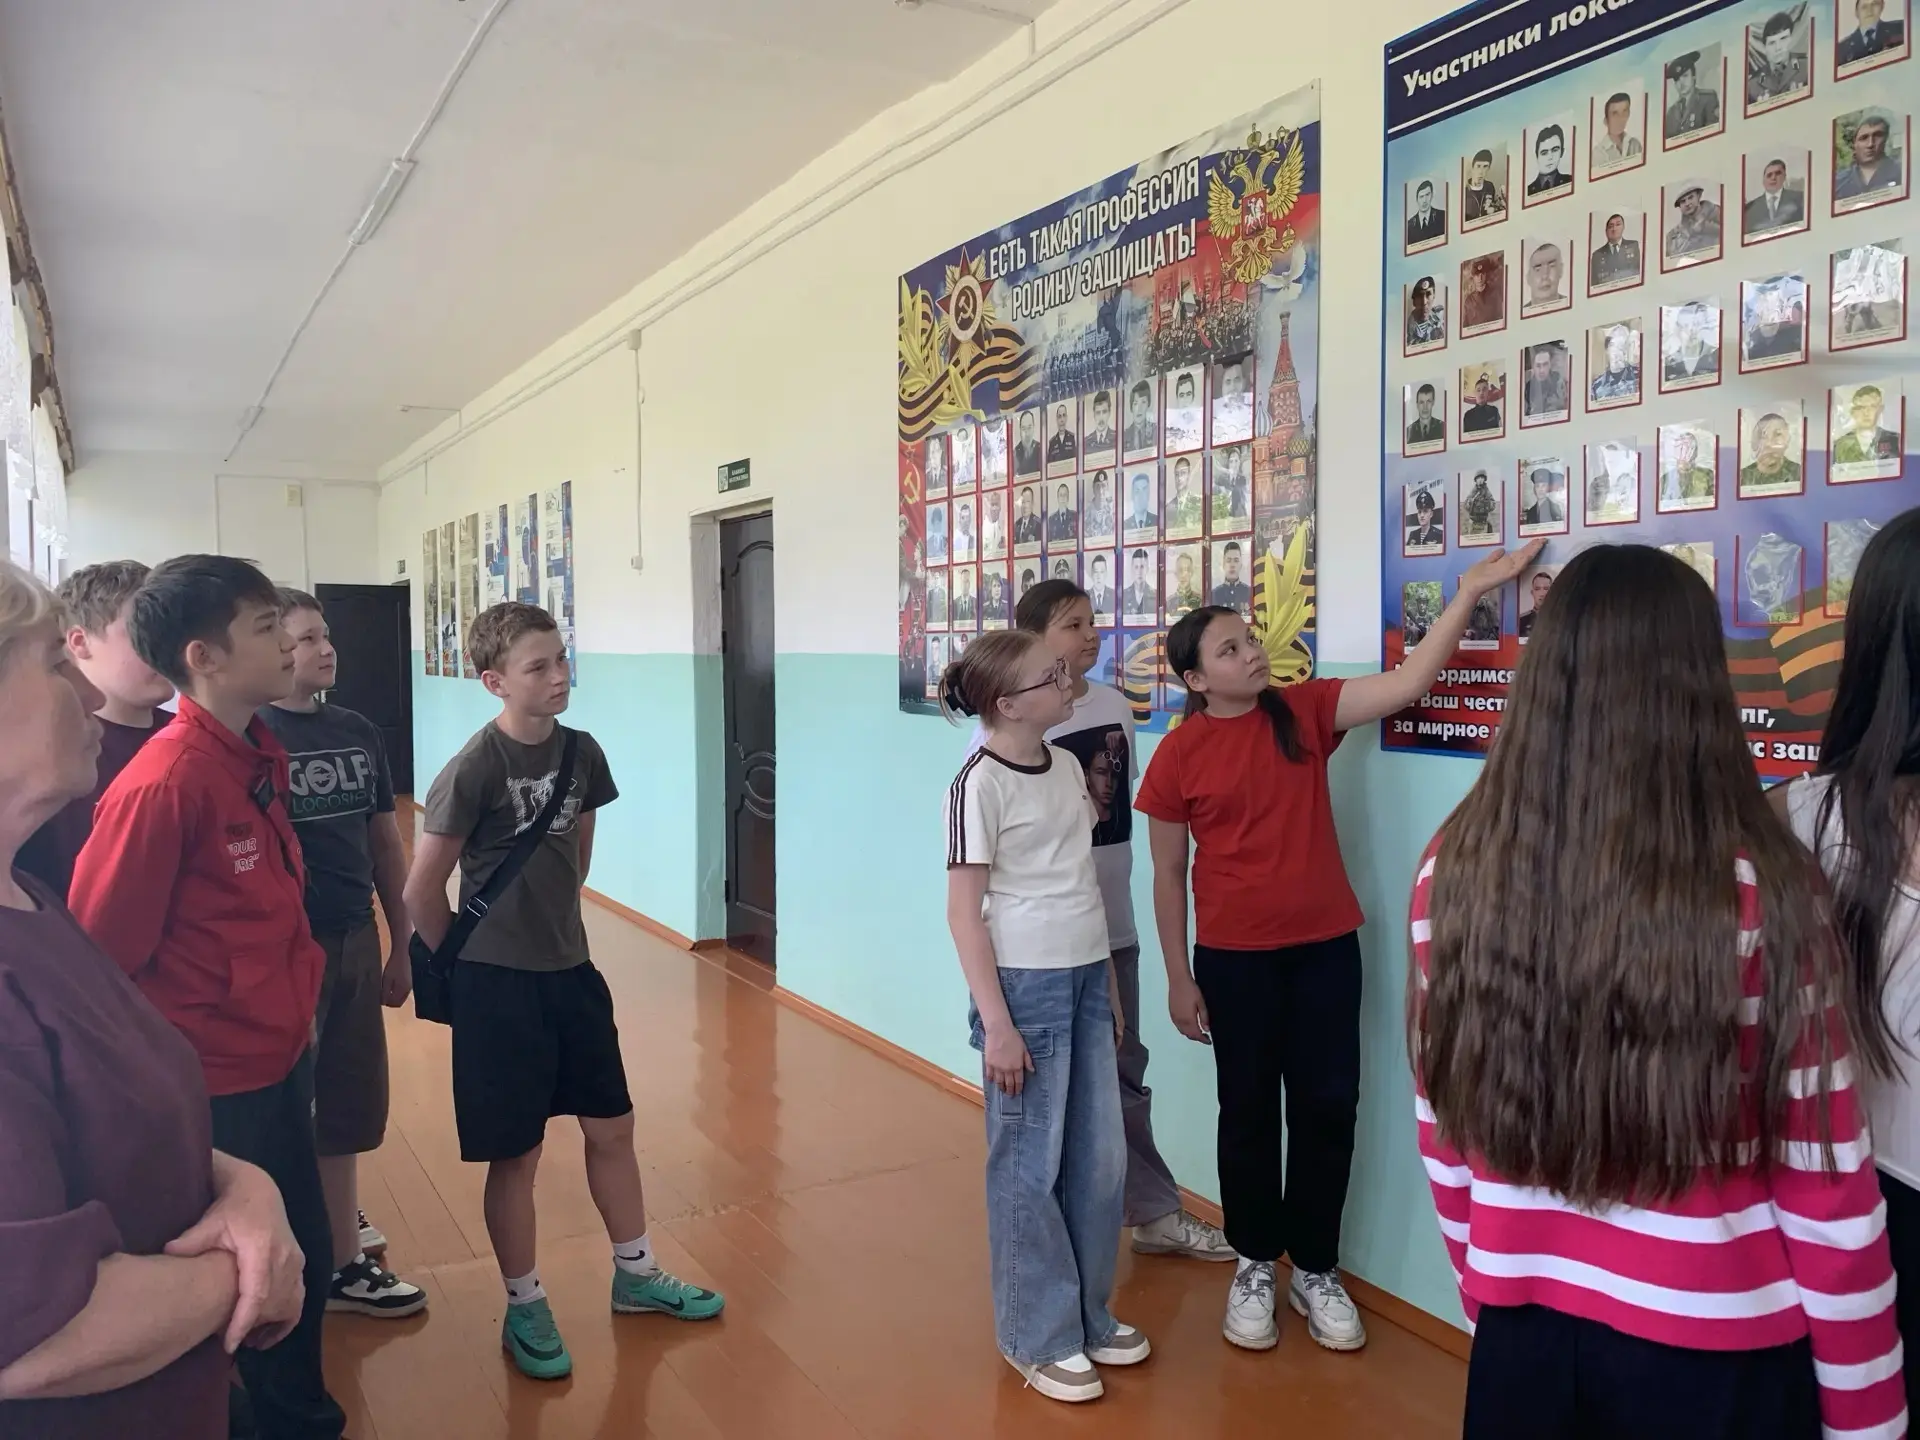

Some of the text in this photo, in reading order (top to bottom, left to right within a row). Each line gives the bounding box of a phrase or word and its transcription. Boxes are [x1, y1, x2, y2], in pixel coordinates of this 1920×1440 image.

[1403, 0, 1635, 97] Участники лока
[989, 236, 1027, 280] ЕСТЬ
[1030, 210, 1083, 264] ТАКАЯ
[1086, 157, 1200, 242] ПРОФЕССИЯ
[1012, 218, 1196, 321] РОДИНУ ЗАЩИЩАТЬ!
[1437, 668, 1516, 688] ордимся
[1393, 720, 1413, 733] за
[1418, 721, 1490, 741] мирное
[1420, 692, 1459, 710] Ваш
[1741, 707, 1776, 728] лг,
[288, 754, 369, 796] GOLF
